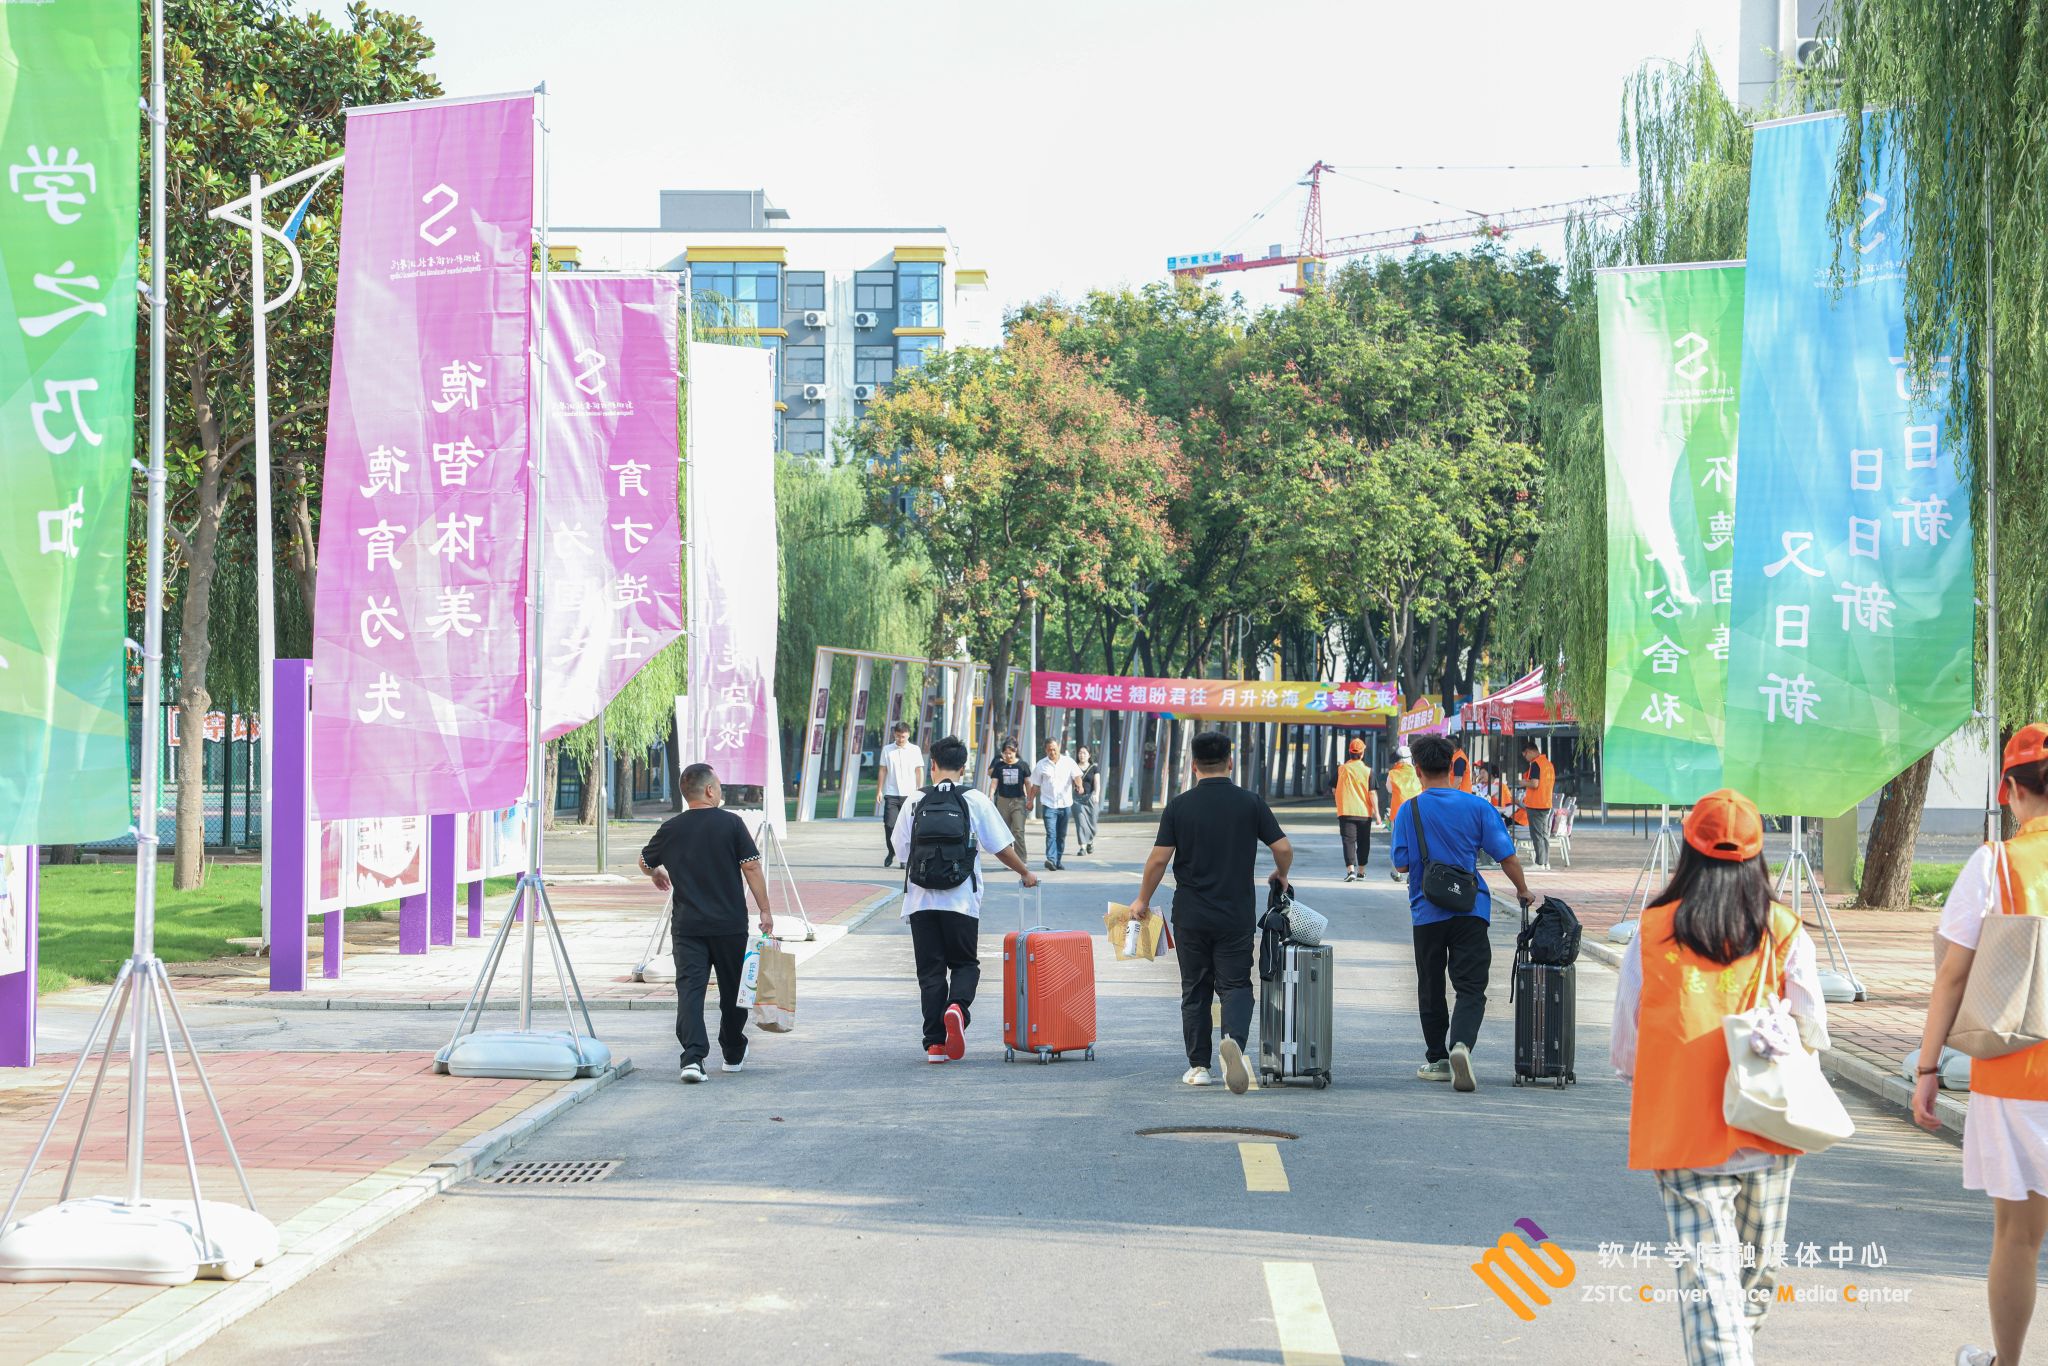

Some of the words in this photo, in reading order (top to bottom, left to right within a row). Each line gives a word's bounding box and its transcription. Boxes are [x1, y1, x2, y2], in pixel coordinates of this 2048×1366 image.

[1045, 680, 1123, 703] 星汉灿烂
[1128, 685, 1208, 706] 翘盼君往
[1219, 688, 1300, 709] 月升沧海
[1311, 689, 1394, 709] 只等你来
